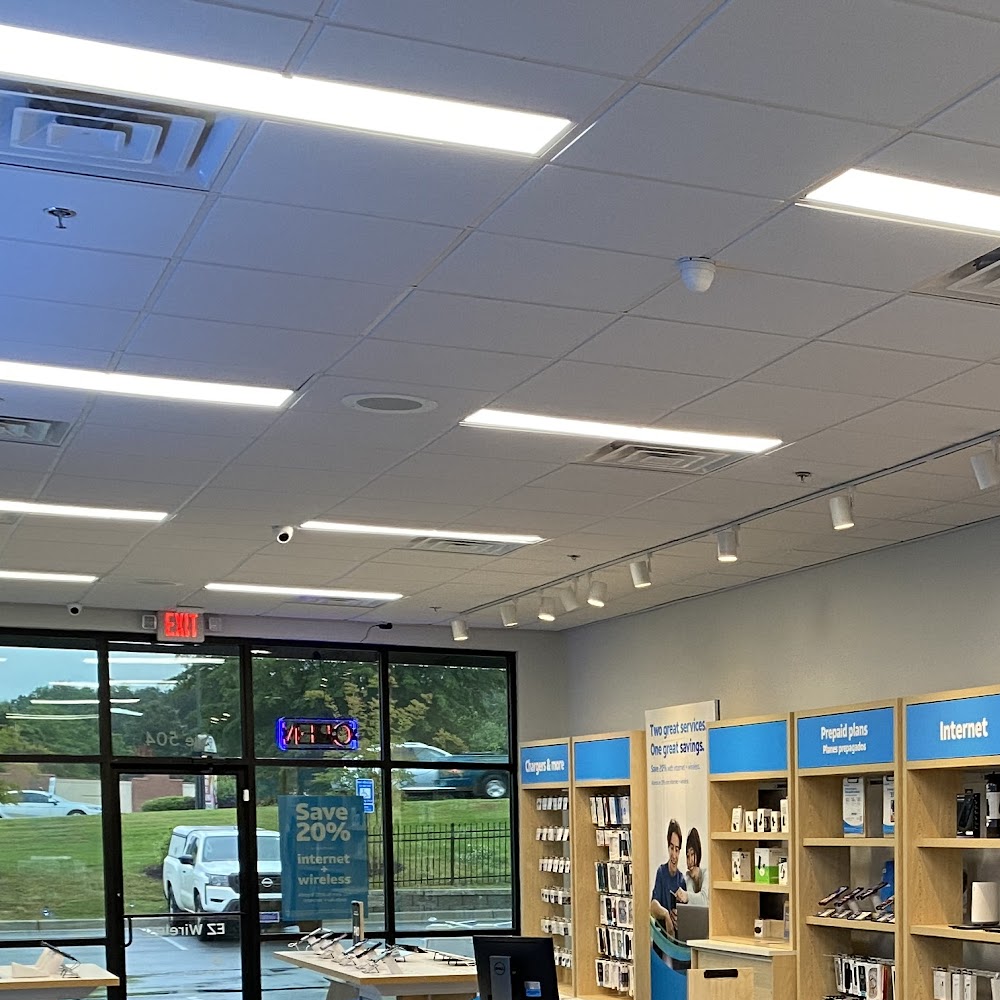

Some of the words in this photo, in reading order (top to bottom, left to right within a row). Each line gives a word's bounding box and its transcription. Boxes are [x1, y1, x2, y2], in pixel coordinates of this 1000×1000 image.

[165, 612, 199, 638] EXIT
[650, 724, 662, 736] Two
[663, 722, 679, 739] great
[820, 723, 847, 742] Prepaid
[848, 722, 868, 741] plans
[940, 717, 988, 740] Internet
[650, 743, 662, 756] One
[663, 742, 679, 759] great
[551, 760, 565, 771] more
[295, 803, 348, 821] Save
[296, 822, 351, 842] 20%
[297, 853, 351, 865] internet
[298, 873, 352, 886] wireless
